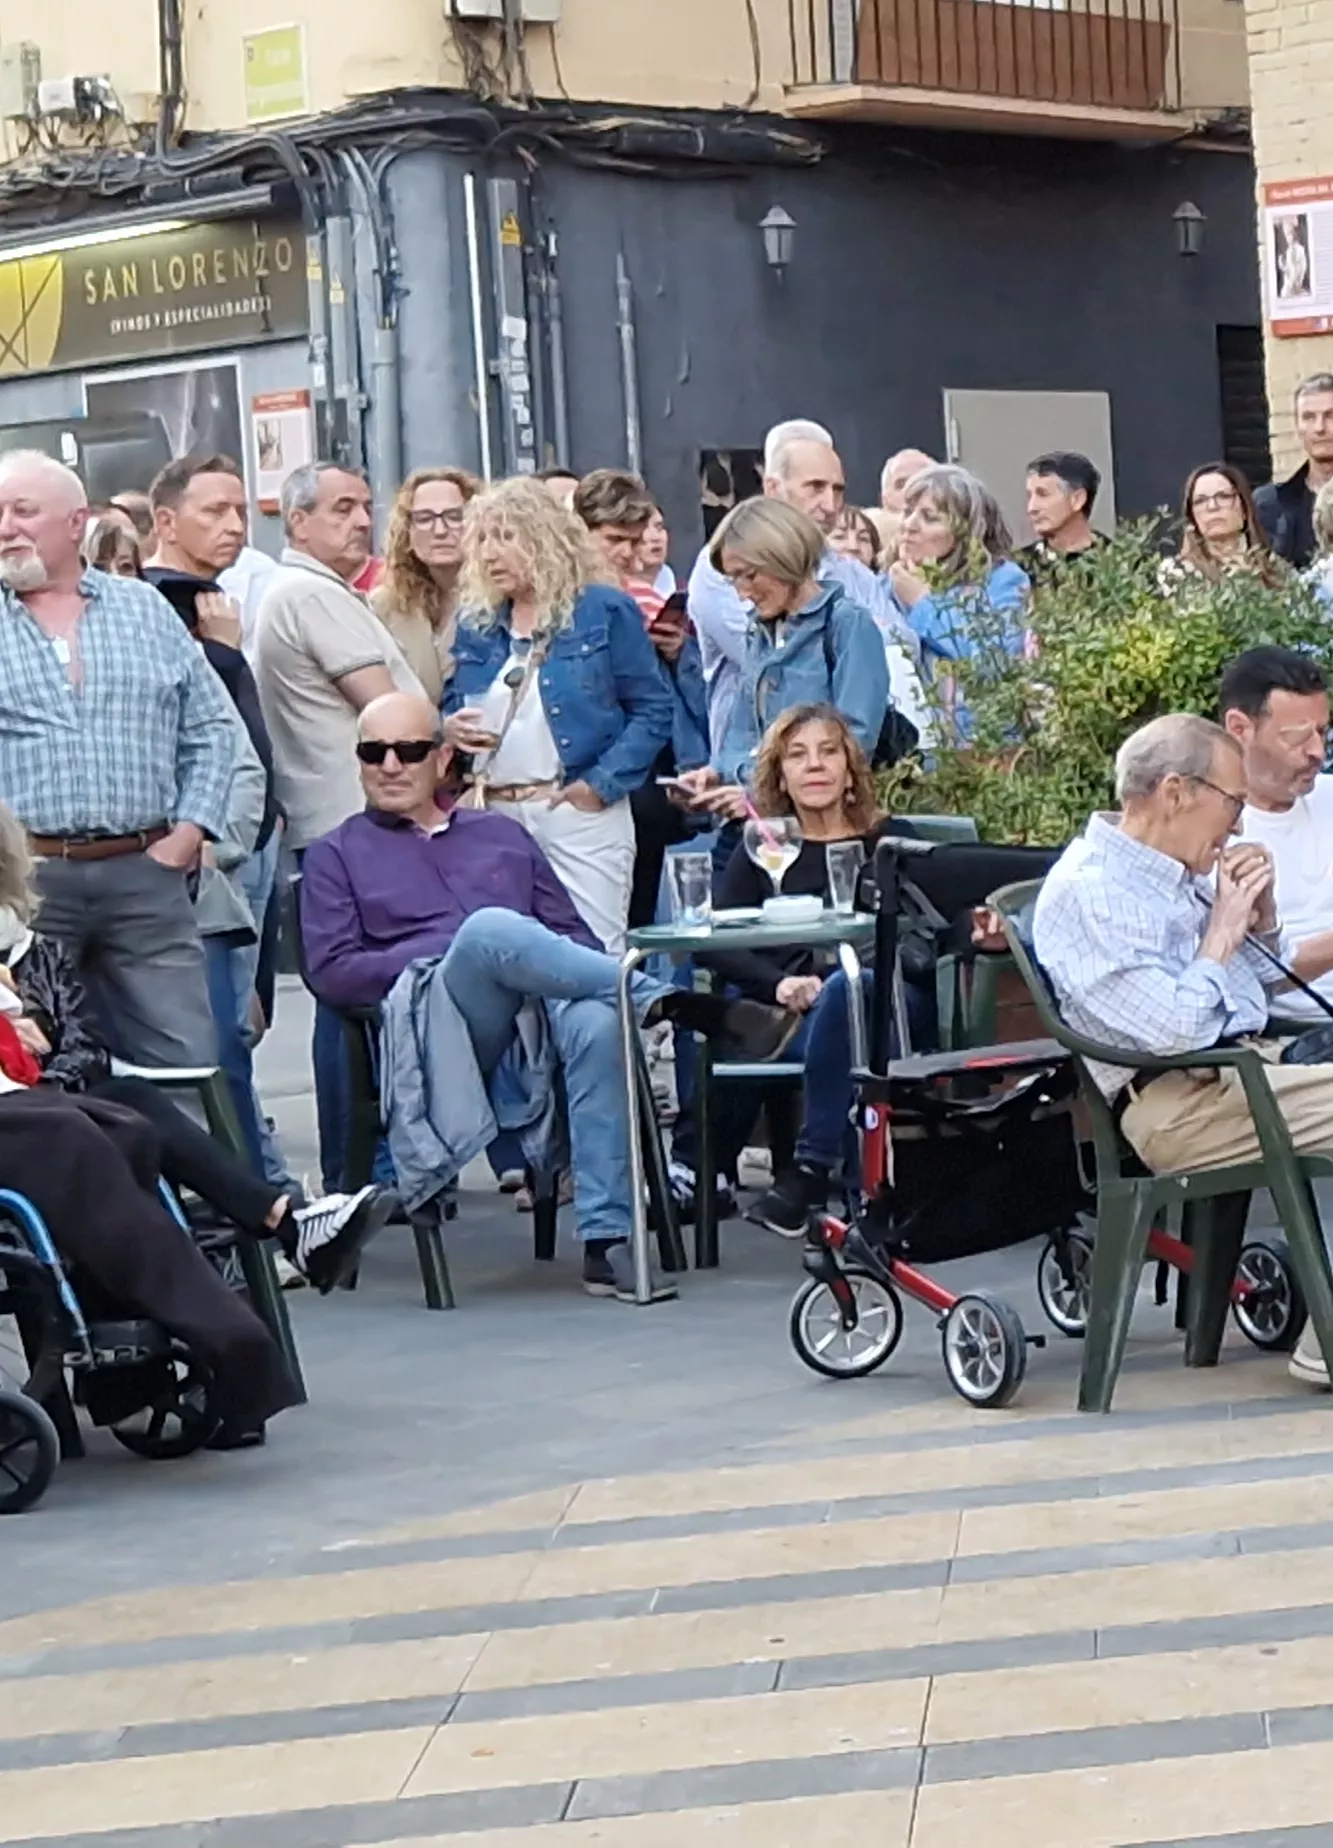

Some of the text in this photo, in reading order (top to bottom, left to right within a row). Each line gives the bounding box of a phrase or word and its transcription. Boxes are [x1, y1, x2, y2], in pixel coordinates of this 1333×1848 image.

[84, 236, 292, 305] SAN LORENZO
[153, 311, 161, 328] Y
